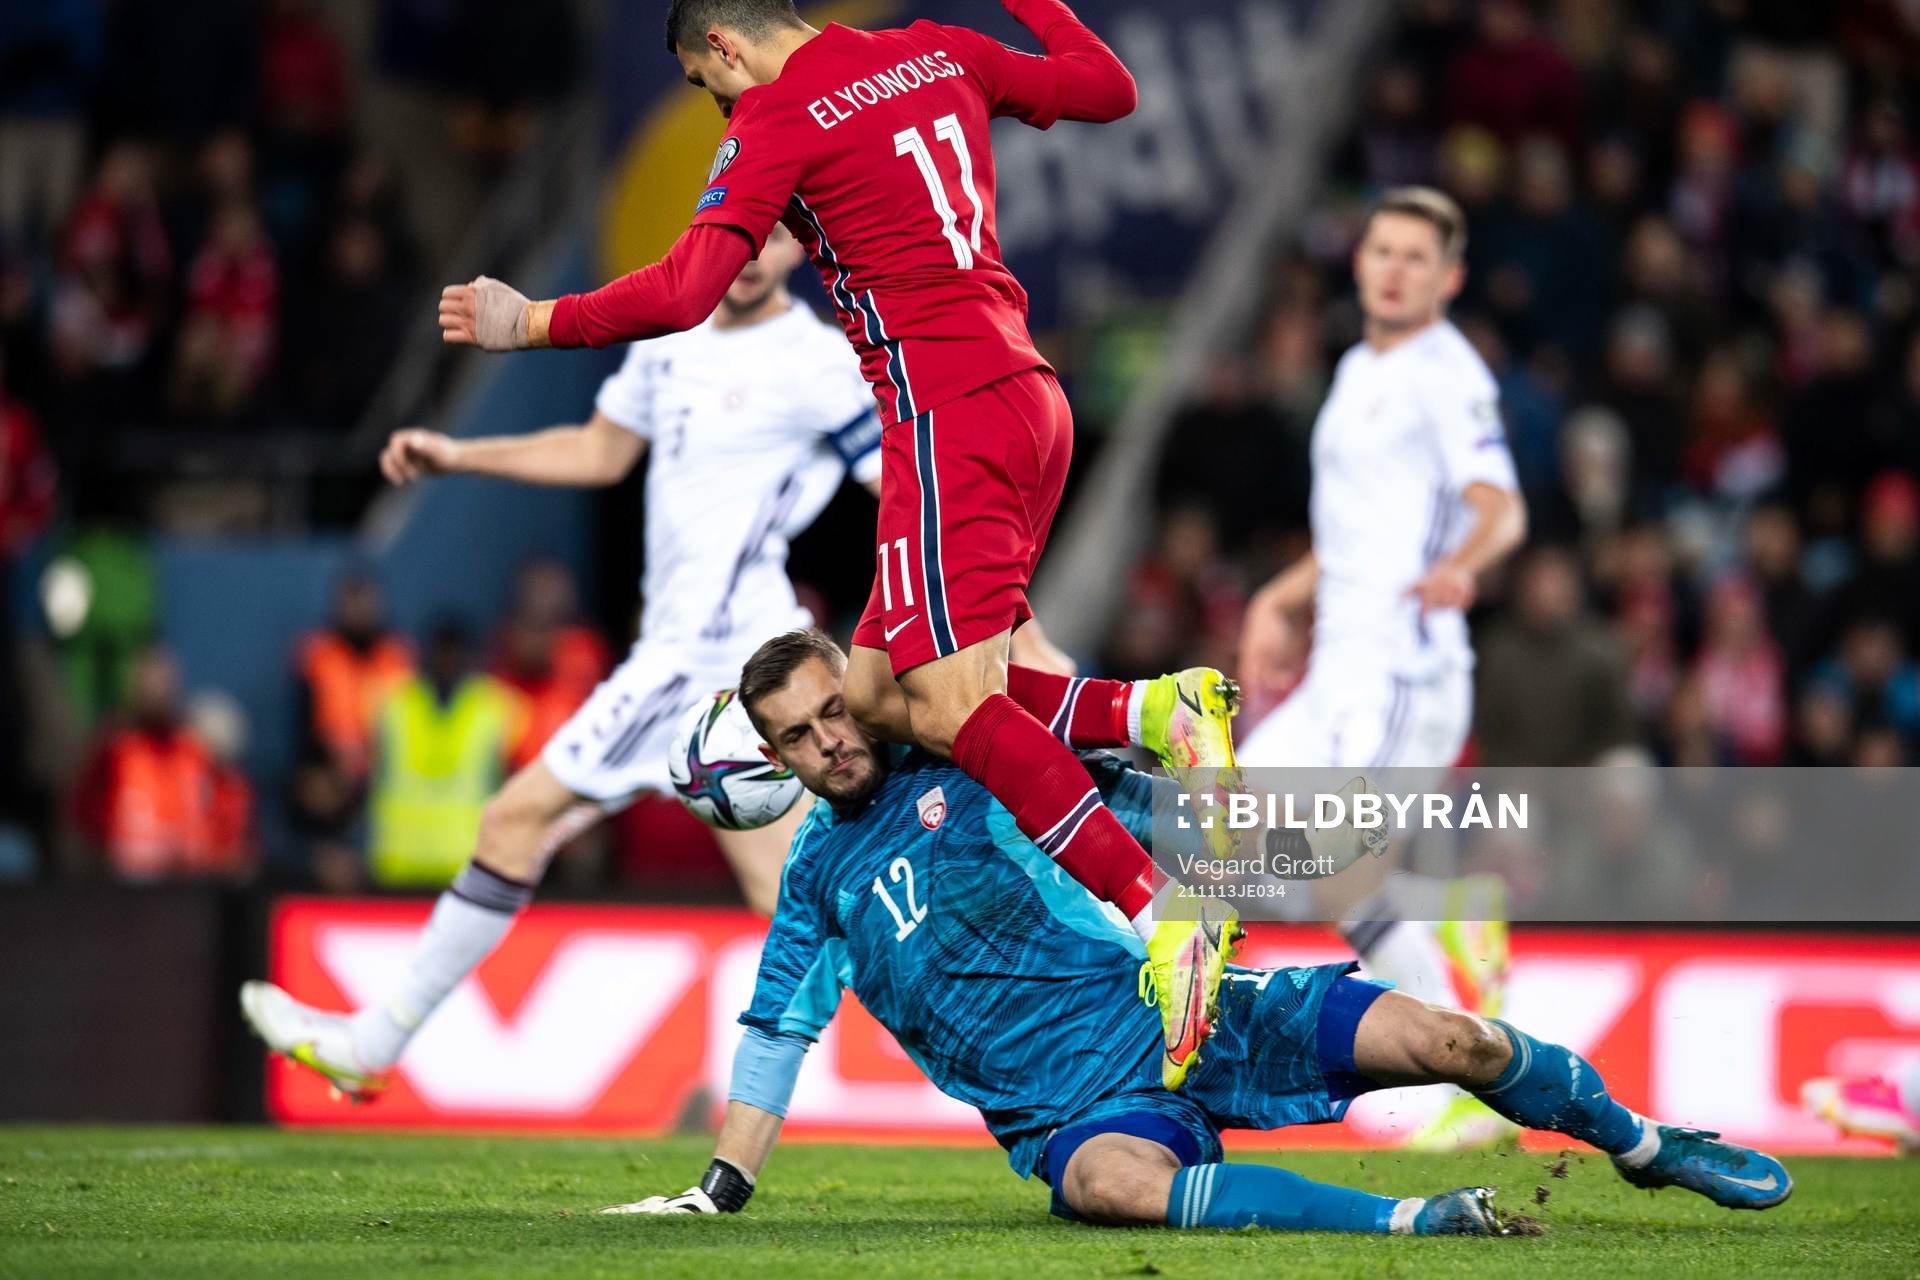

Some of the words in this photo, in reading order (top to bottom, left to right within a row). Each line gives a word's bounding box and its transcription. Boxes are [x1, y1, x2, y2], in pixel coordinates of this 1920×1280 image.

[893, 113, 984, 270] 11
[879, 537, 914, 611] 11
[872, 857, 928, 942] 12
